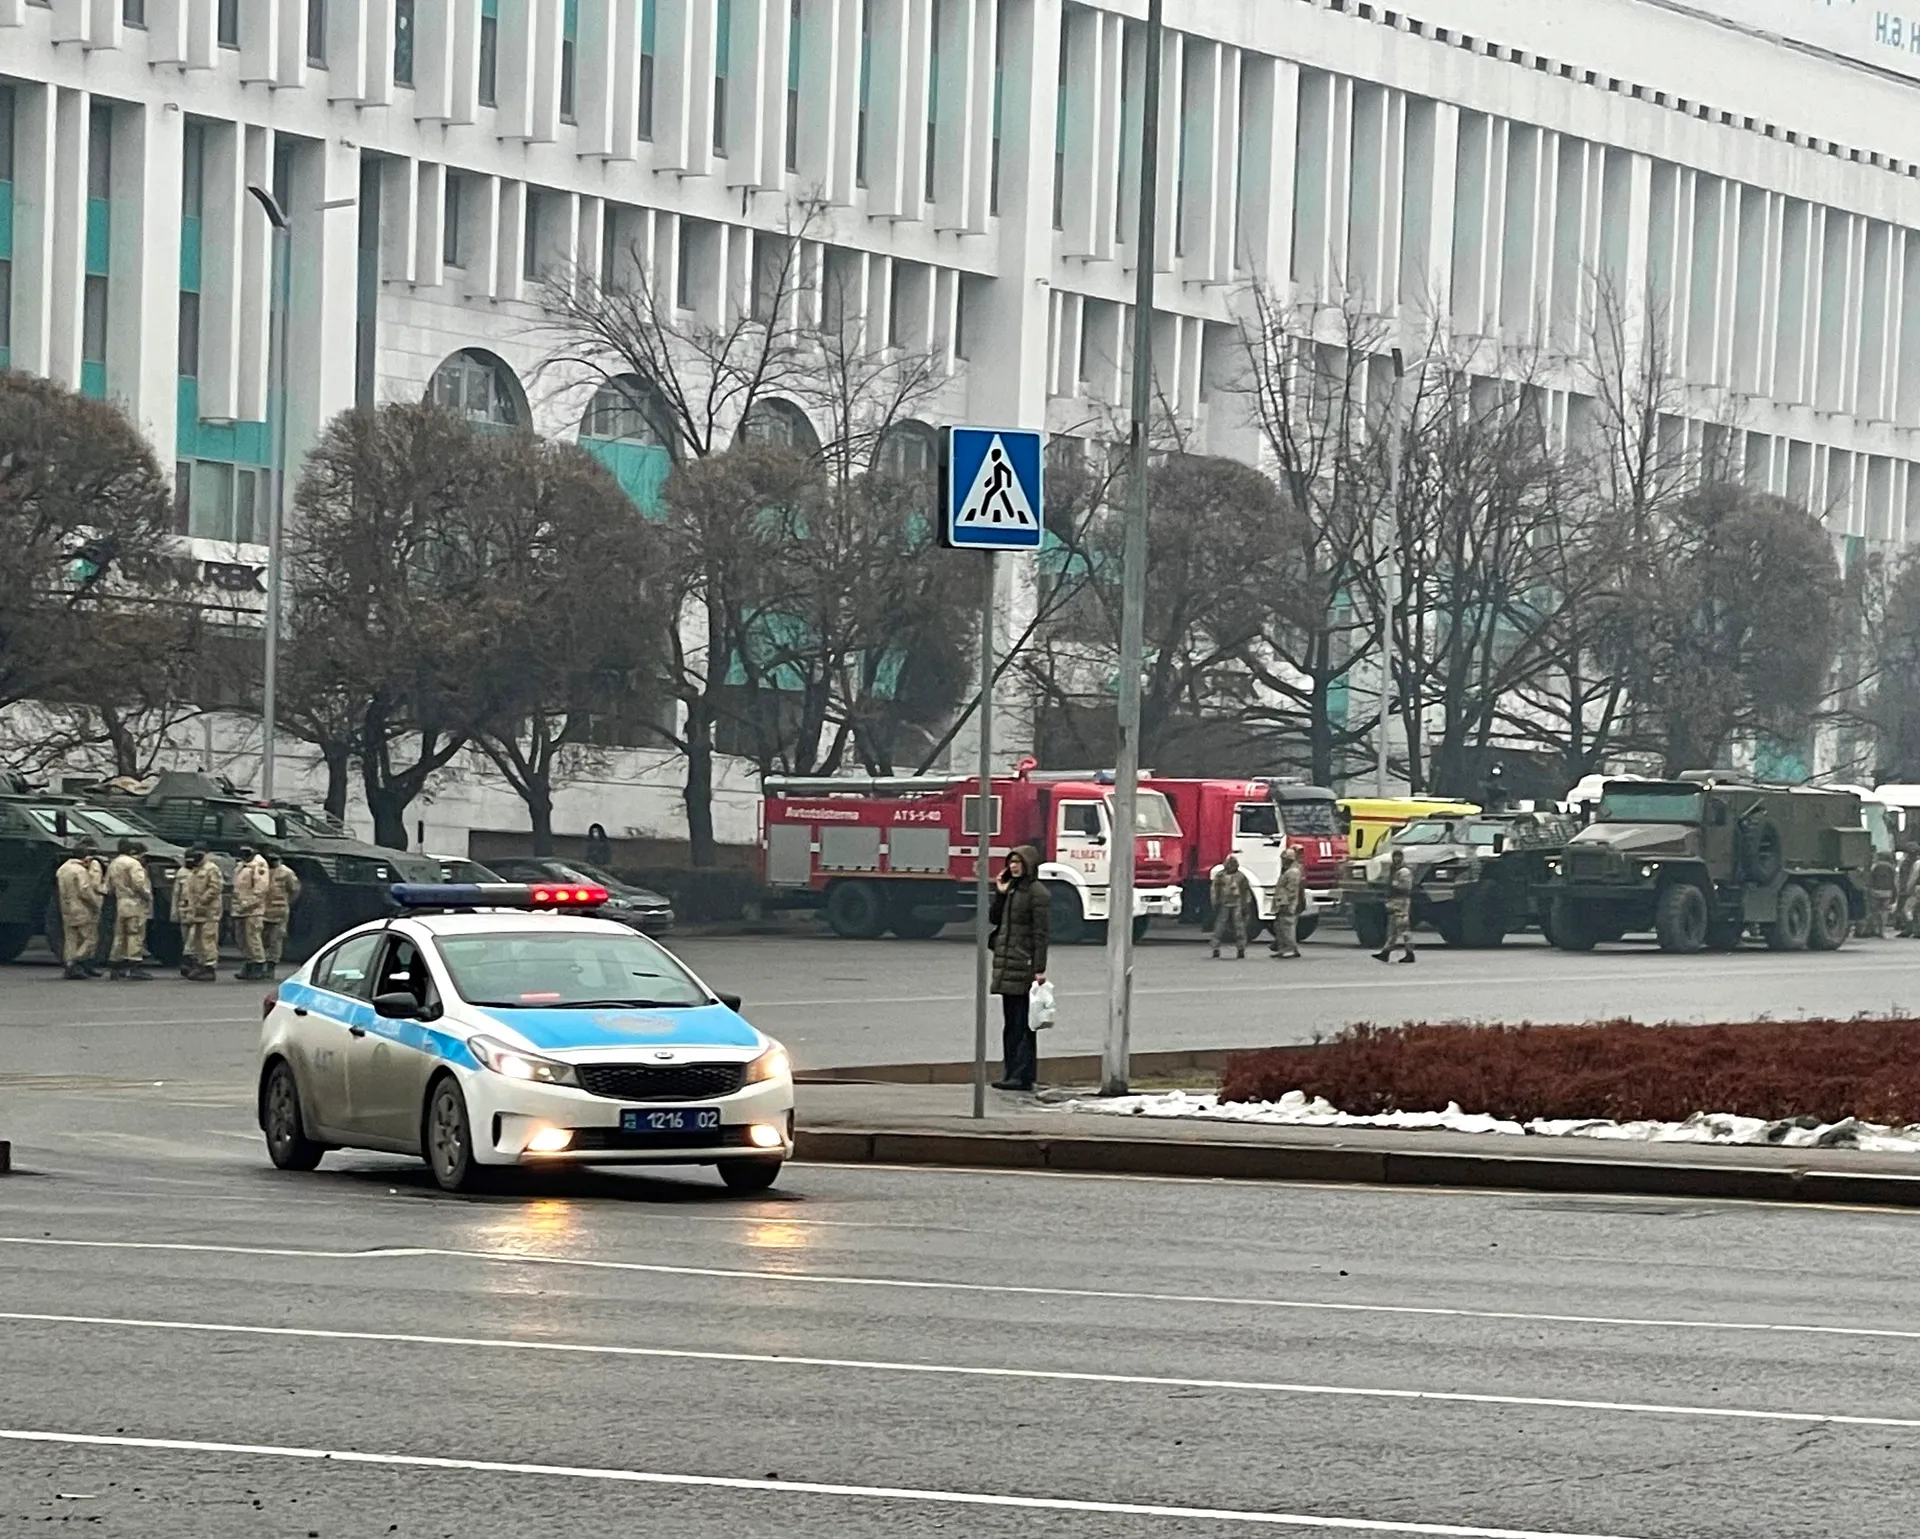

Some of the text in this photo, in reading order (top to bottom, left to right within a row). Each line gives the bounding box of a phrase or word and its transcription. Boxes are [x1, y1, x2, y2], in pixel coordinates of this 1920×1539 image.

[1070, 850, 1107, 860] ALMATY
[1084, 863, 1096, 873] 12
[647, 1112, 684, 1128] 1216
[698, 1111, 718, 1128] 02
